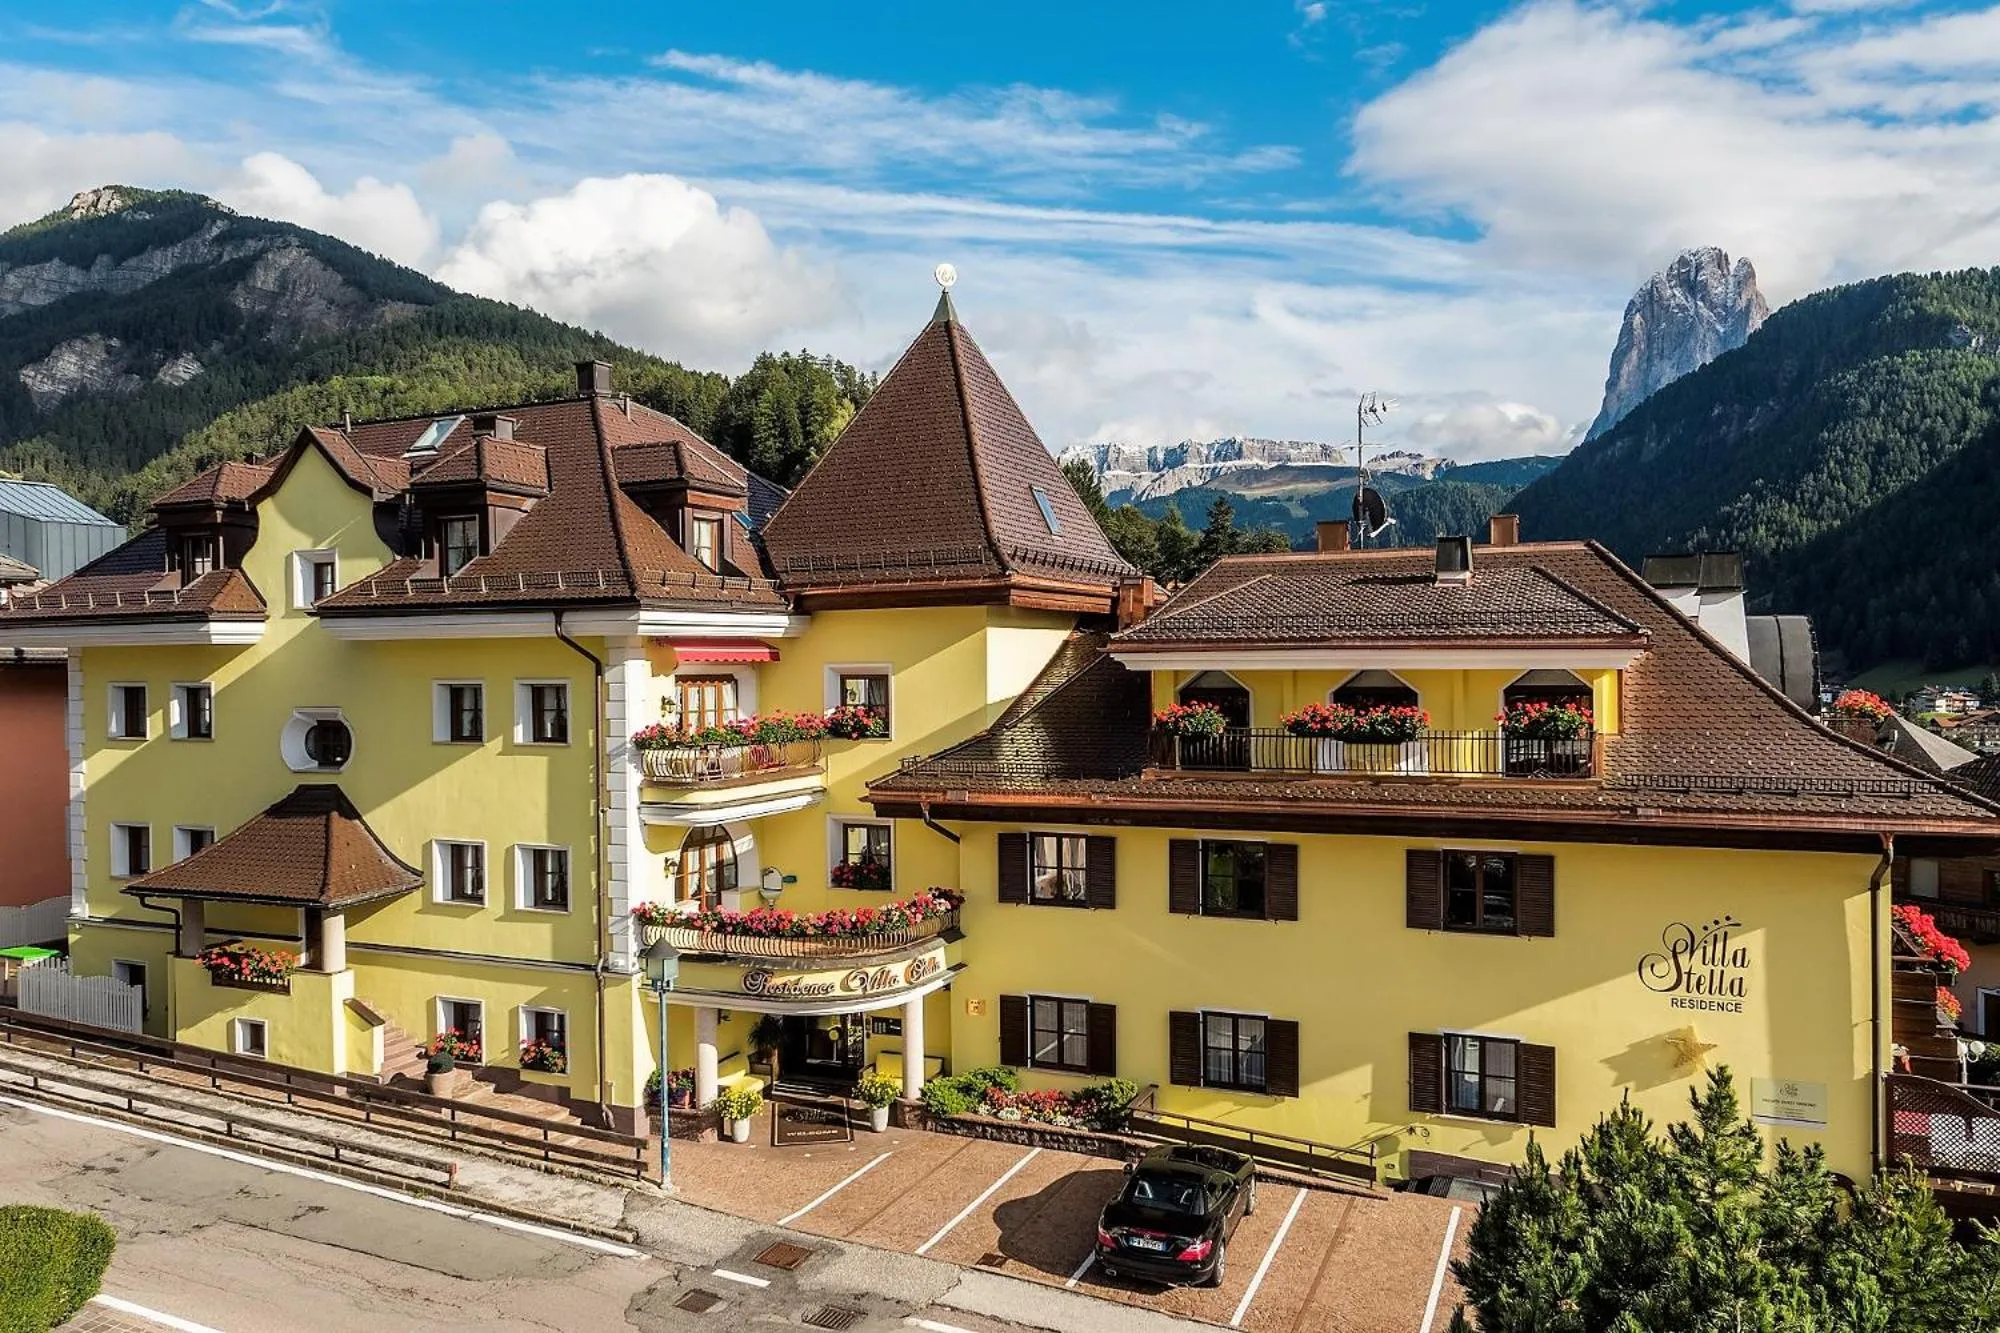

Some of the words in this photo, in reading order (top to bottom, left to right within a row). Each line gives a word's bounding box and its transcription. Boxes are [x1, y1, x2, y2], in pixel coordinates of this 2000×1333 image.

[1662, 922, 1751, 969] Villa
[742, 968, 836, 996] Residence
[840, 965, 900, 993] Villa
[1638, 938, 1749, 998] Stella
[1670, 997, 1743, 1013] RESIDENCE
